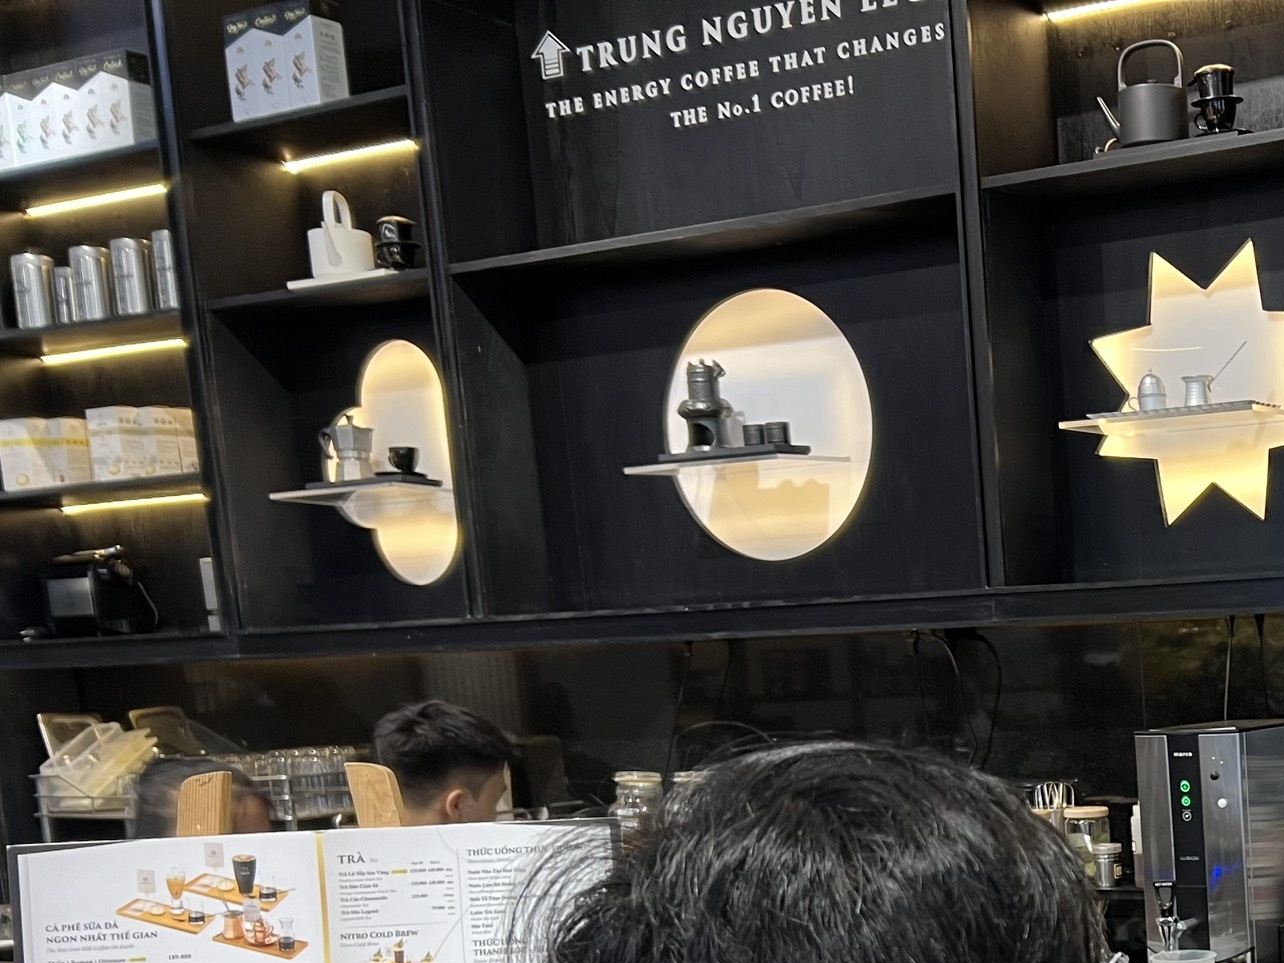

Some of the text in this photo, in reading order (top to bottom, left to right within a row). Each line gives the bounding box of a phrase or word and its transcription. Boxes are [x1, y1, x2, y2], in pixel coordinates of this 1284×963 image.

[576, 25, 687, 72] TRUNG
[545, 22, 946, 119] THE ENERGY COFFEE THAT CHANGES
[670, 75, 854, 128] THE No.1 COFFEE!
[467, 845, 522, 856] THỨC UỐNG
[337, 851, 365, 864] TRÀ
[45, 920, 118, 932] CÀ PHÊ SỮA ĐÁ
[46, 931, 158, 944] NGON NHẤT THẾ GIAN
[472, 938, 500, 947] THỨC
